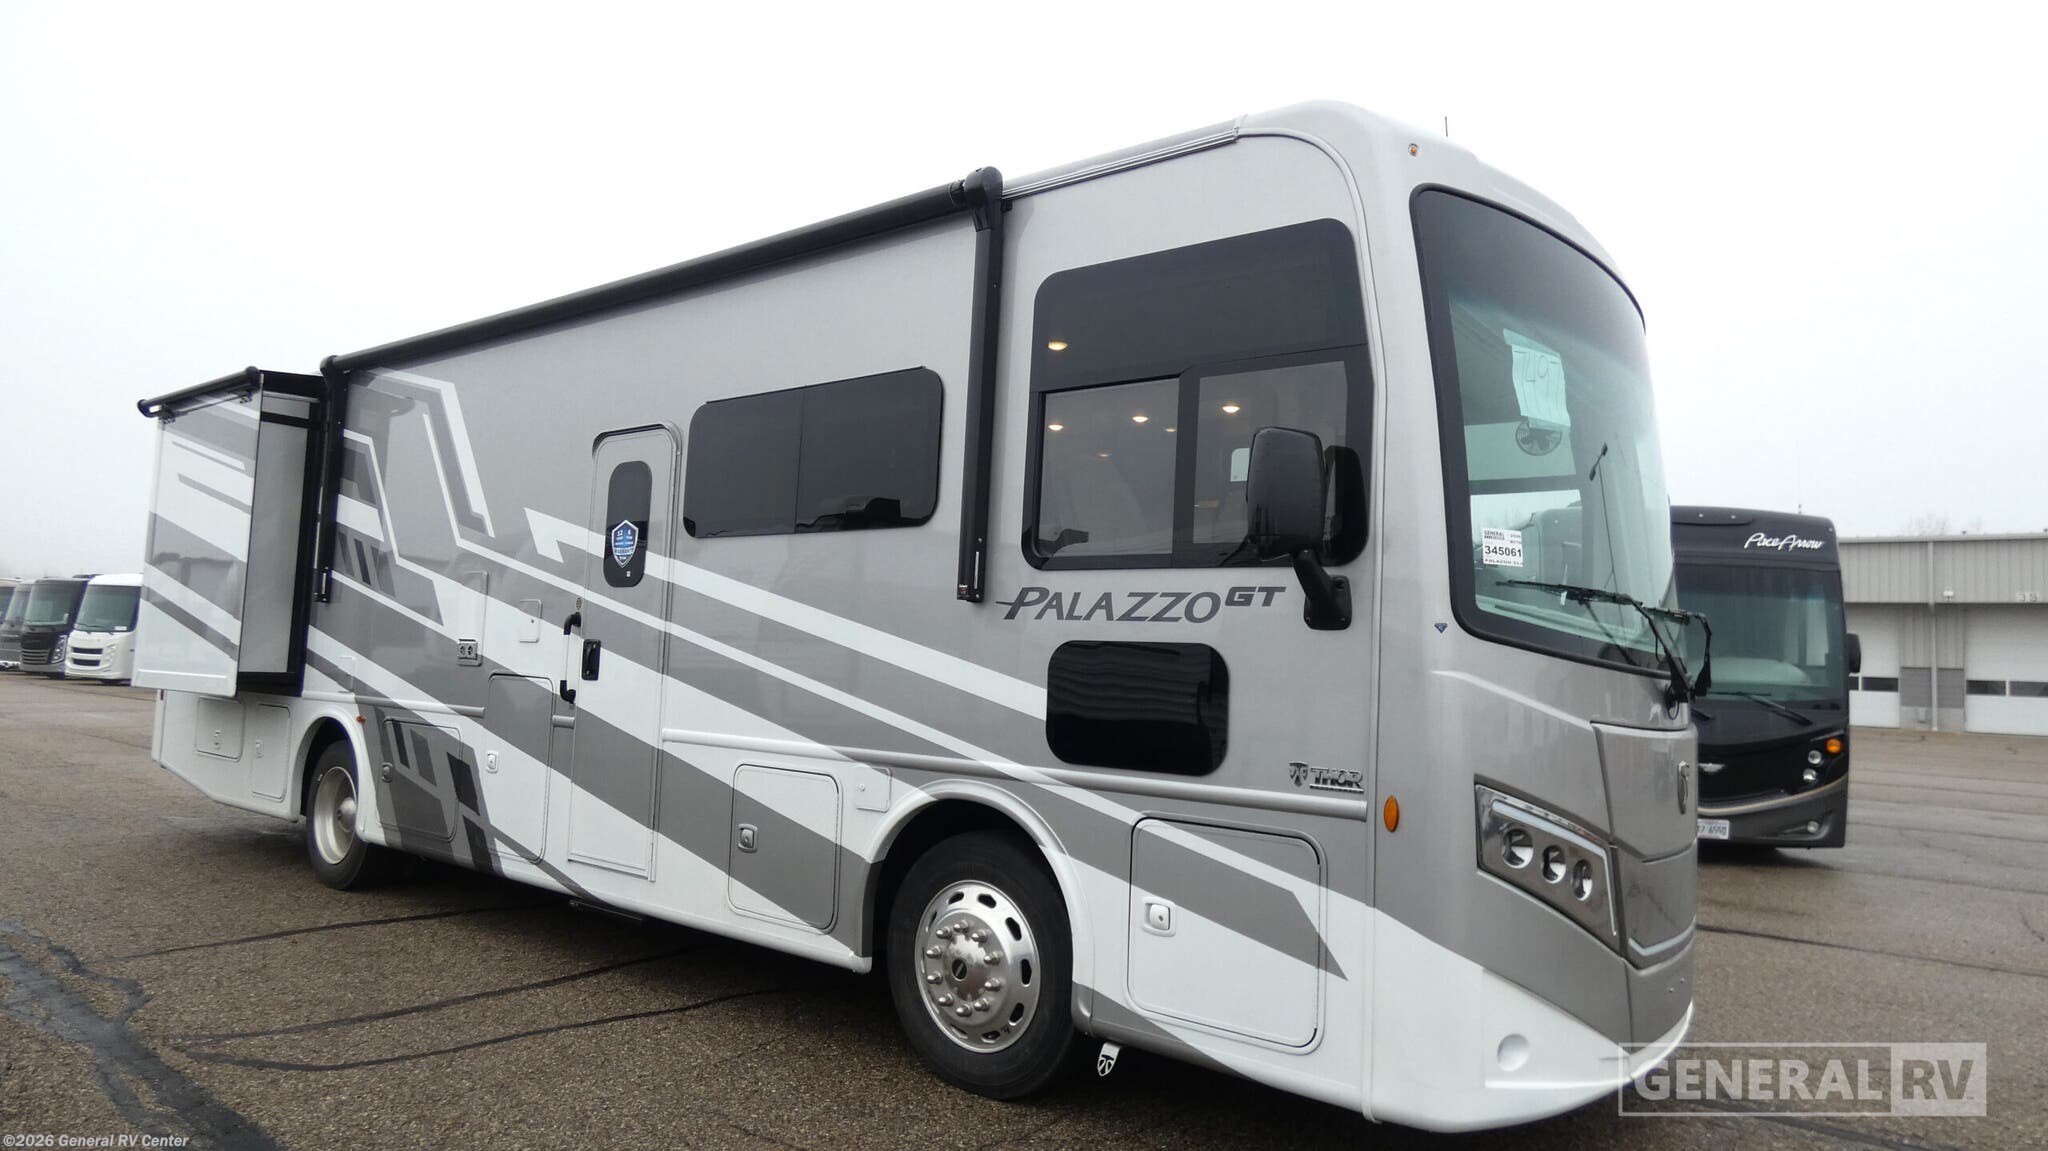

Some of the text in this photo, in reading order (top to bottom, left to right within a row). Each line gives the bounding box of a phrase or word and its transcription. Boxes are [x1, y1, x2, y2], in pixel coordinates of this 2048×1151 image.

[1485, 545, 1521, 557] 345061
[1744, 532, 1823, 551] Pace Arrow
[996, 586, 1286, 623] PALAZZO GT
[1310, 767, 1363, 789] THOR
